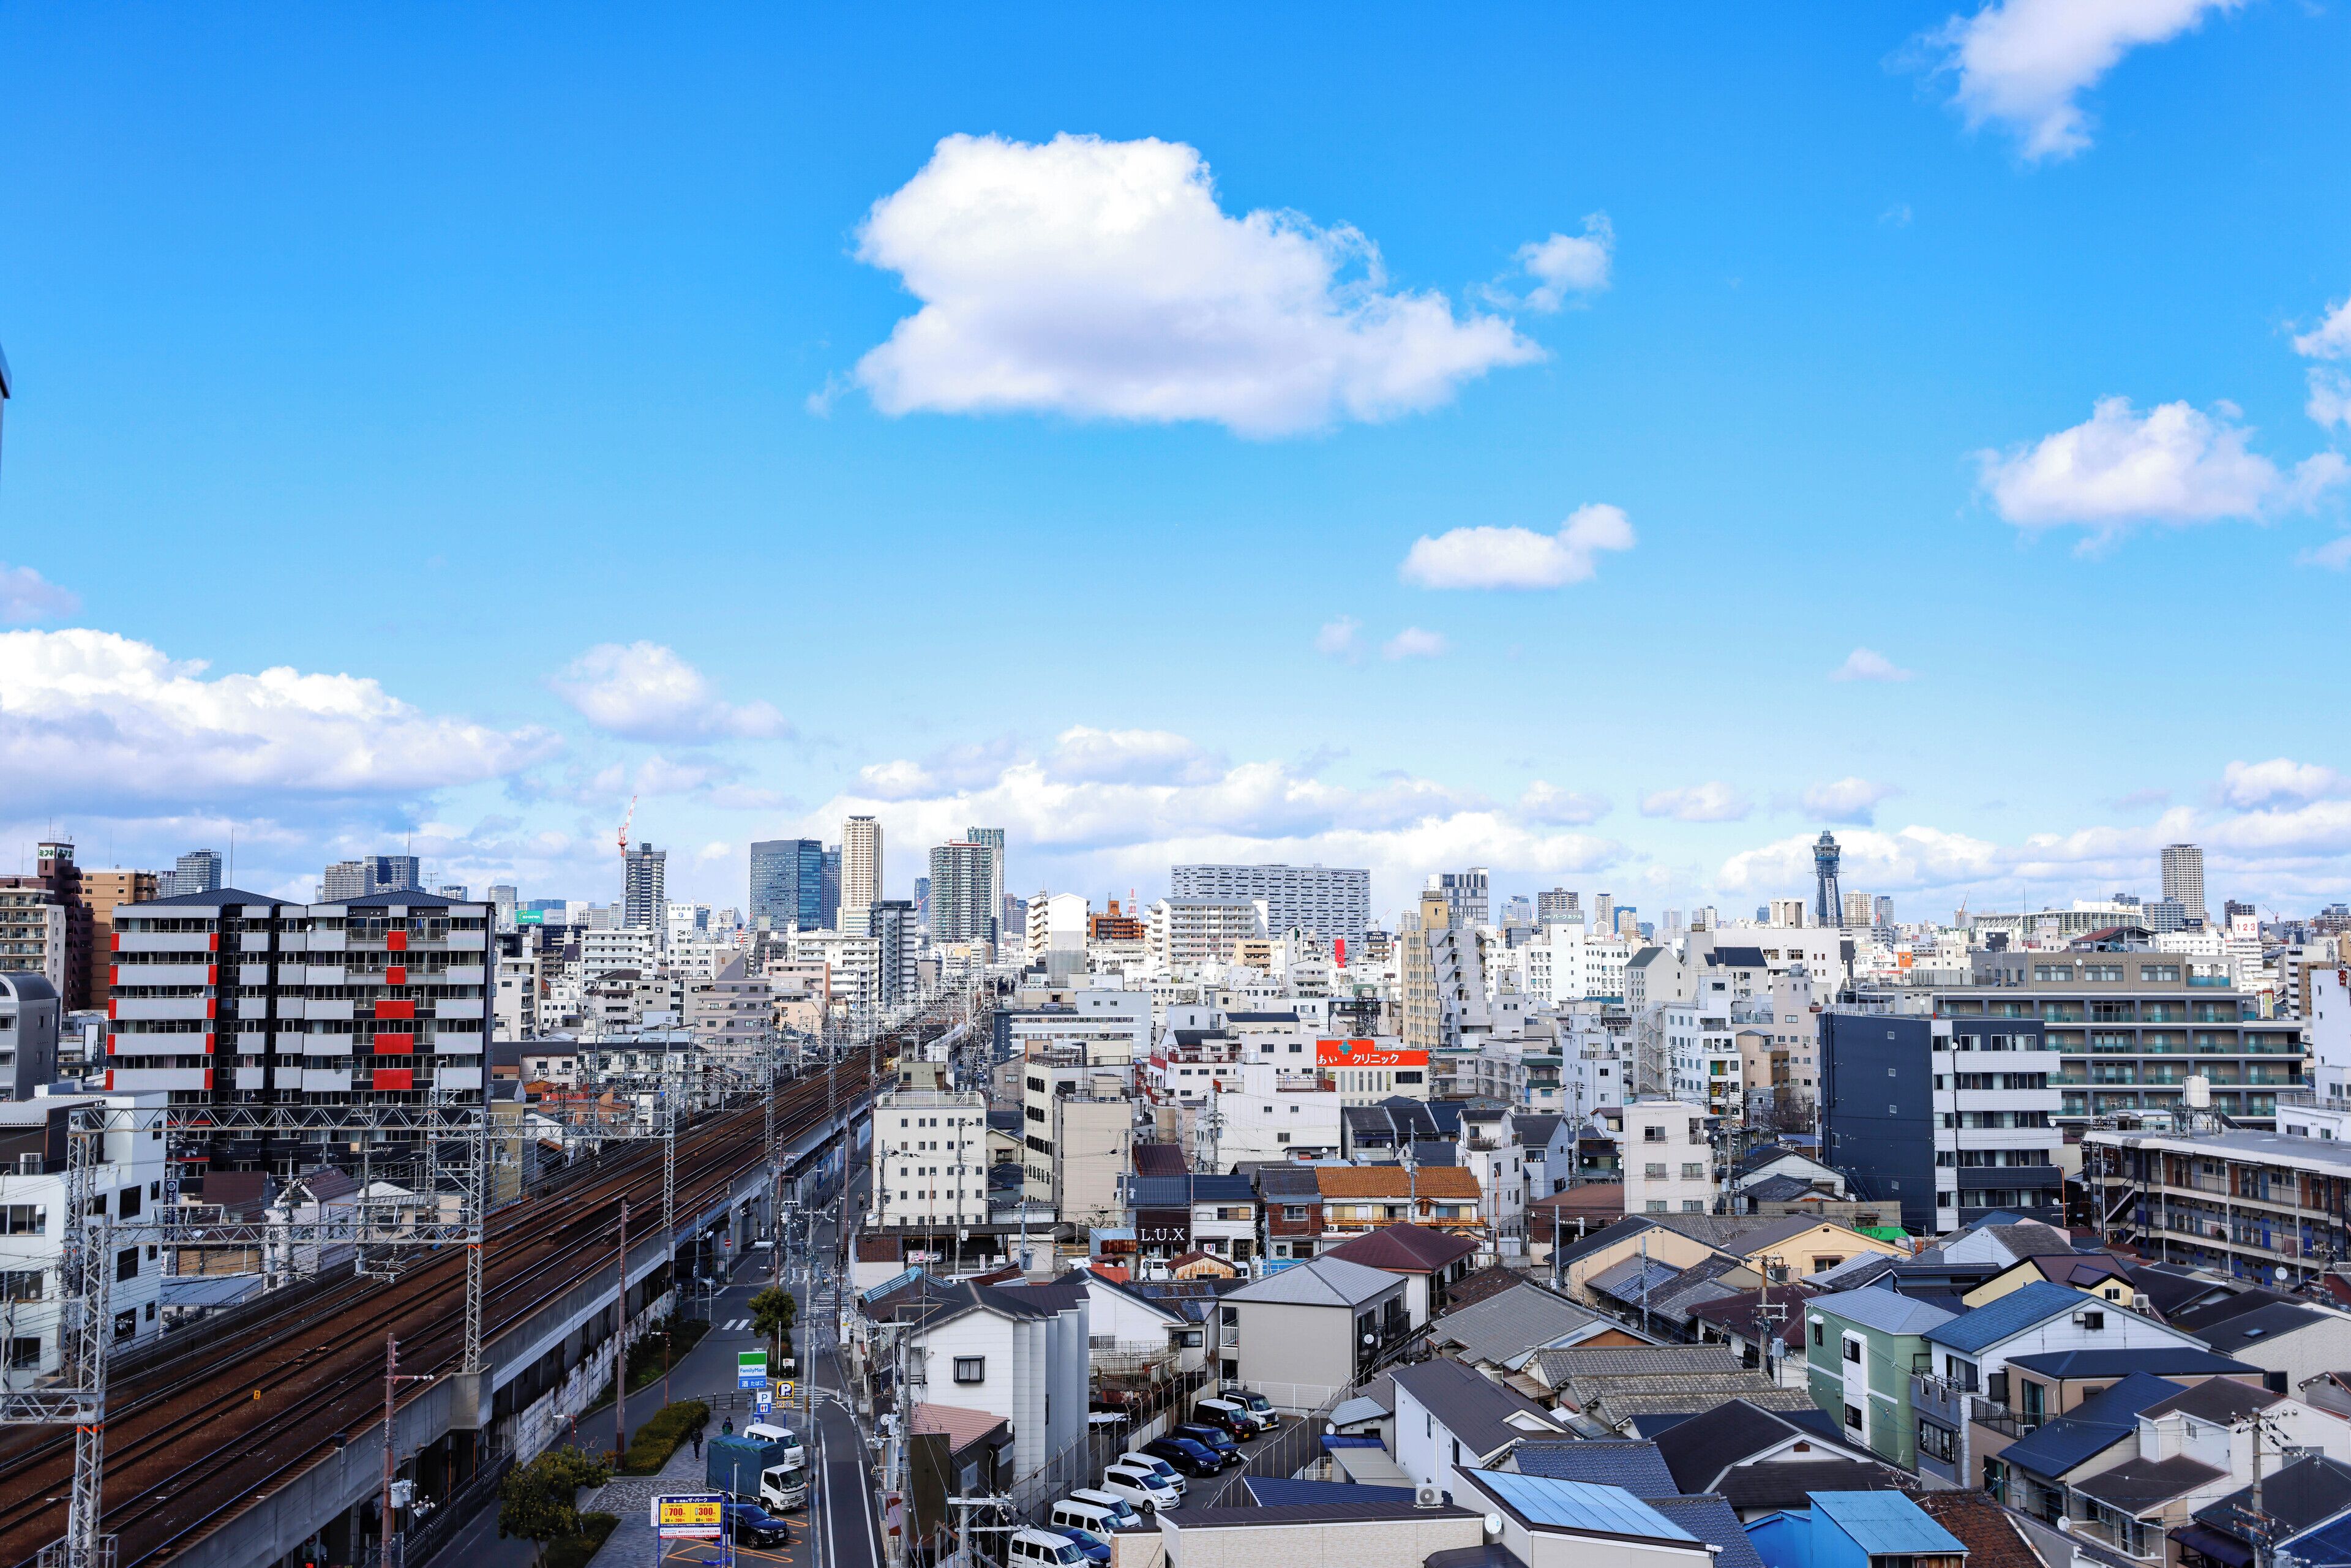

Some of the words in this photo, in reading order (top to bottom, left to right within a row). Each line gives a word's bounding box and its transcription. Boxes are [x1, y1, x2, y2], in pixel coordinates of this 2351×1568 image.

[39, 849, 54, 858] ミフネ
[1317, 1054, 1338, 1065] あい
[1352, 1053, 1399, 1064] クリニック
[1141, 1228, 1185, 1241] L.U.X
[781, 1384, 791, 1396] P
[762, 1394, 768, 1402] P
